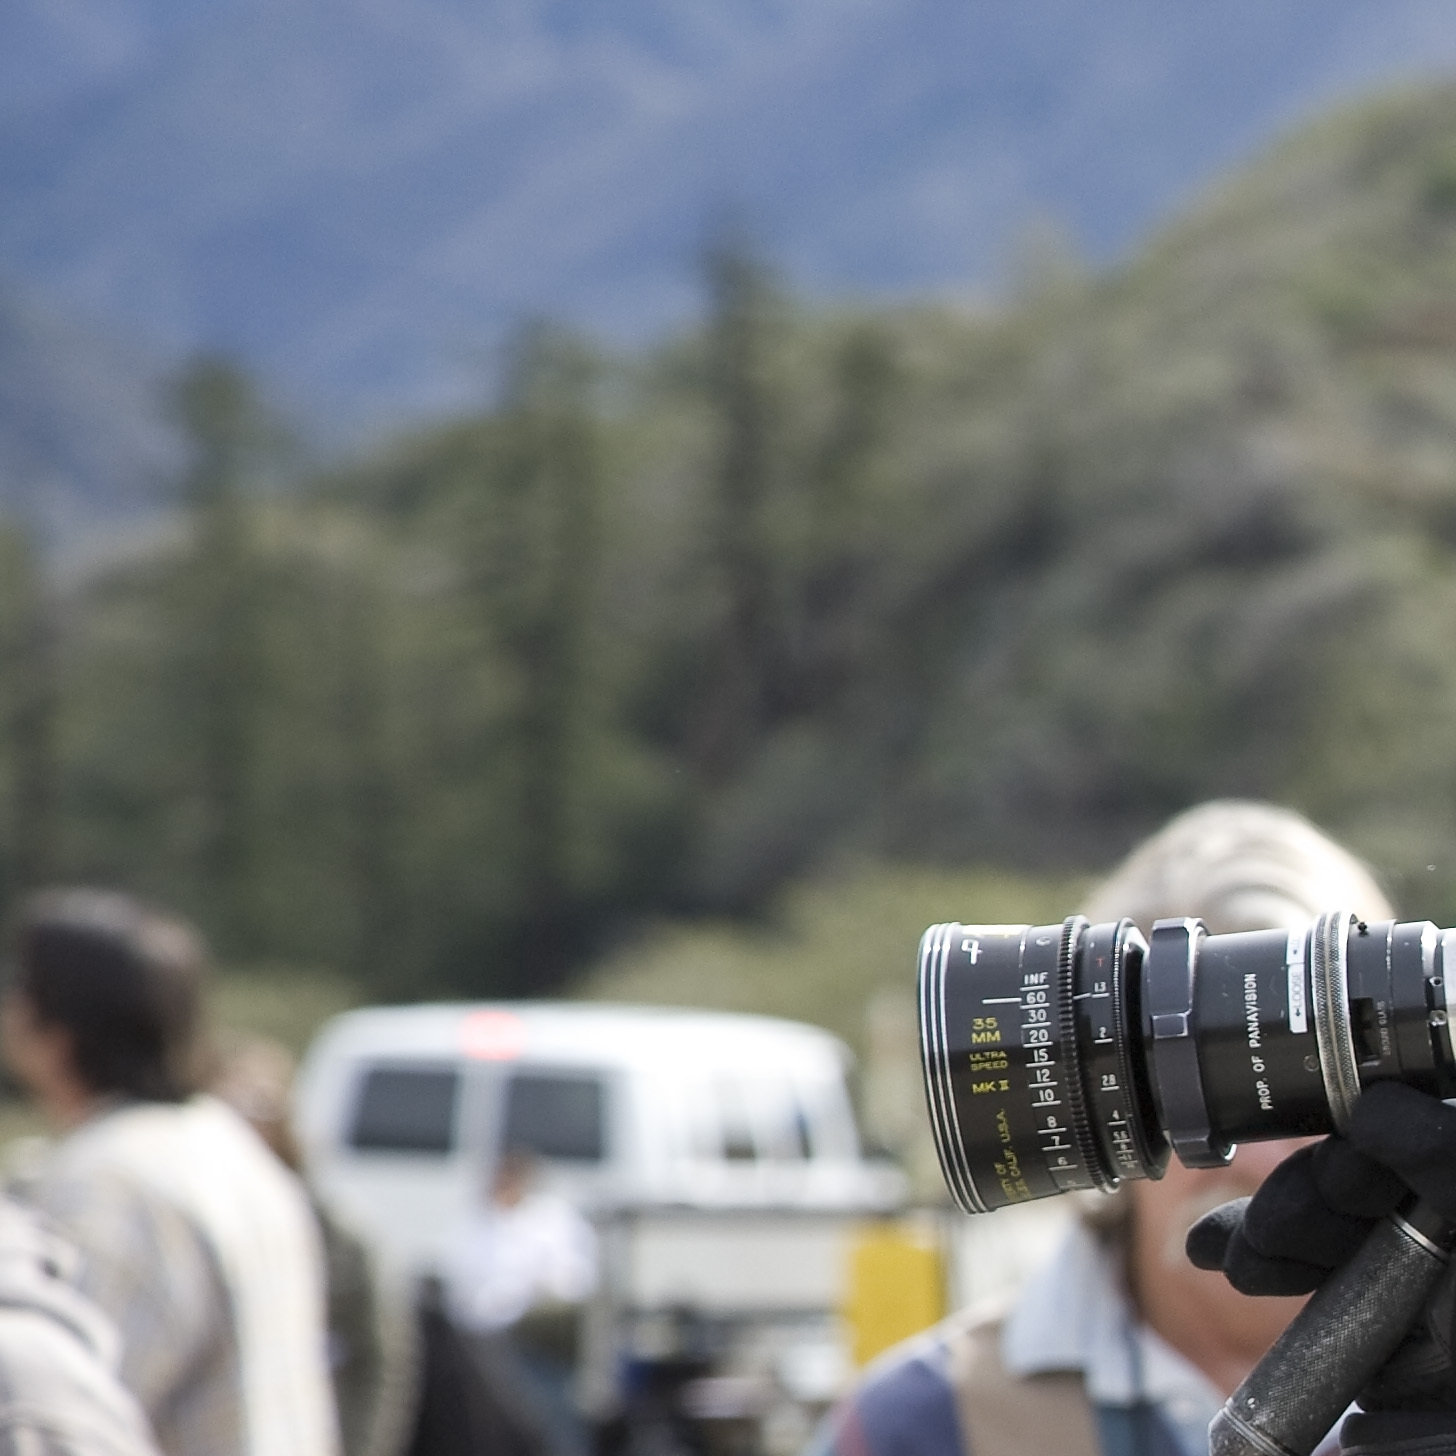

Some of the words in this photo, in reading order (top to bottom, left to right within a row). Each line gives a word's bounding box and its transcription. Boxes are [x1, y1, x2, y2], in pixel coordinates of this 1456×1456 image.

[1023, 972, 1049, 985] INF
[1291, 972, 1303, 1008] LOOSE
[1026, 992, 1047, 1003] 60
[1028, 1010, 1047, 1022] 30
[1244, 973, 1261, 1048] PANAVISION
[972, 1017, 998, 1030] 35
[971, 1030, 1001, 1044] MM
[1029, 1029, 1049, 1042] 20
[1099, 1027, 1107, 1038] 2
[969, 1051, 1007, 1060] ULTRA
[1034, 1050, 1049, 1062] 15
[970, 1061, 1008, 1071] SPEED
[1251, 1055, 1266, 1072] OF
[1036, 1069, 1051, 1082] 12
[972, 1081, 996, 1094] MK
[1256, 1078, 1274, 1110] PROP.
[1039, 1089, 1055, 1102] 10
[1047, 1115, 1058, 1127] 8
[1112, 1109, 1120, 1120] 4
[1050, 1136, 1060, 1146] 7
